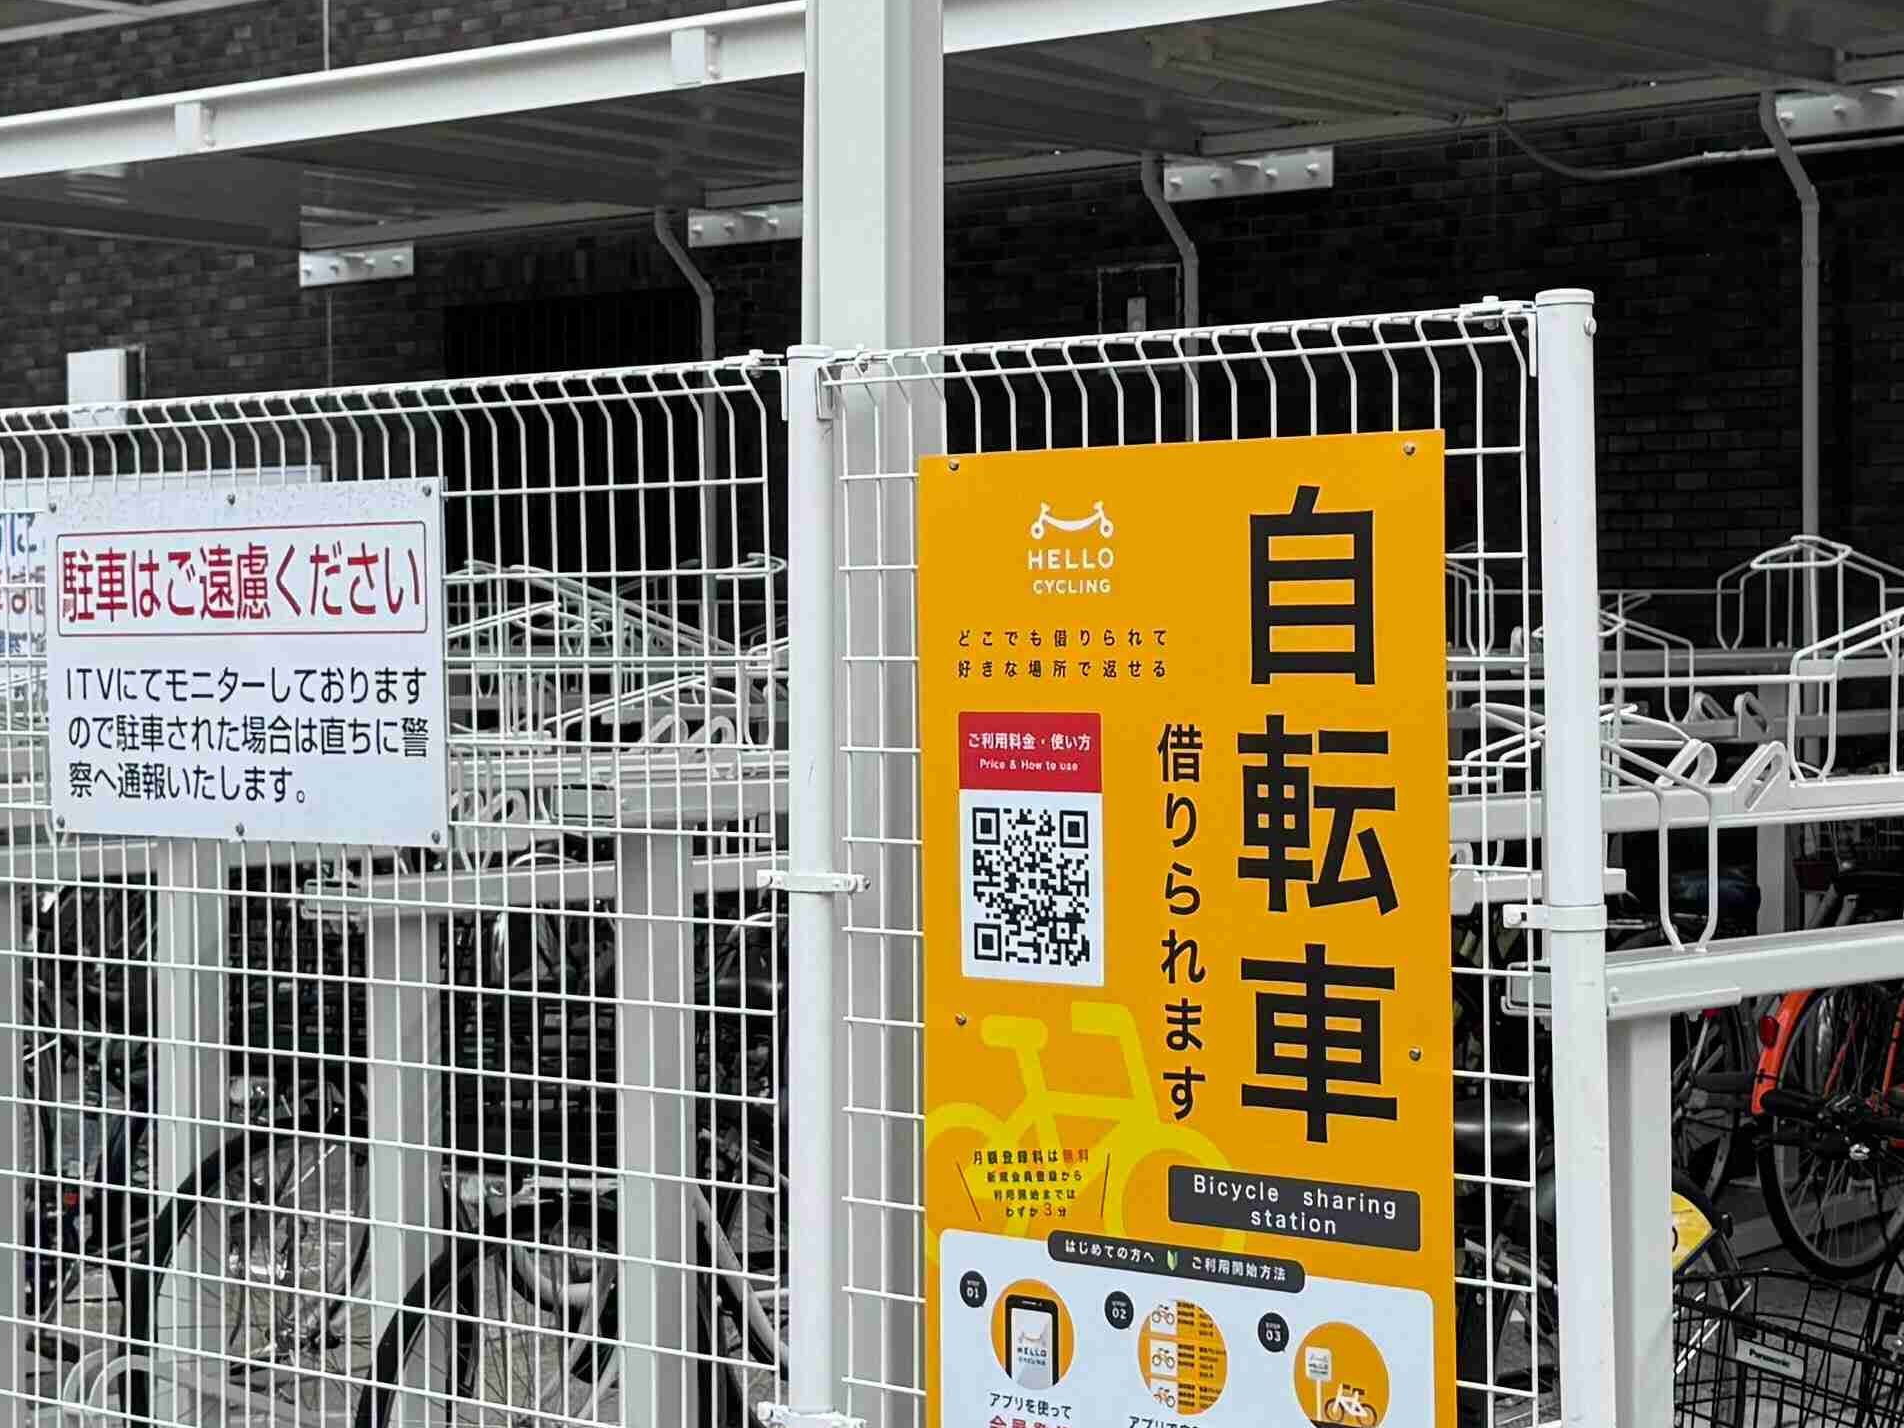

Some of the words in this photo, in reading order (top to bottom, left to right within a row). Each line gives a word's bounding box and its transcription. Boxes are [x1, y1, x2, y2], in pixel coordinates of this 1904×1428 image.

[1027, 547, 1115, 570] HELLO
[61, 539, 421, 622] 駐車はご遠慮ください
[1032, 578, 1112, 595] CYCLING
[957, 628, 1167, 648] どこでも借りられて
[957, 659, 1167, 679] 好きな場所で返せる
[65, 666, 428, 705] ITVにてモニターしております
[67, 715, 429, 758] ので駐車された場合は直ちに警
[968, 732, 1092, 751] ご利用料金・使い方
[979, 758, 1006, 770] Price
[1009, 759, 1017, 770] &
[1021, 759, 1043, 771] How
[1045, 761, 1058, 771] to
[1059, 762, 1079, 772] use
[68, 760, 307, 805] 察へ通報いたします。
[1236, 484, 1399, 1144] 自転車
[1157, 723, 1207, 1122] 借りられます
[1193, 1173, 1280, 1202] Bicycle
[1302, 1187, 1398, 1220] sharing
[1250, 1210, 1337, 1236] station
[1064, 1239, 1156, 1264] はじめての方へ
[1191, 1256, 1287, 1282] ご利用開始方法
[966, 1286, 980, 1298] 01
[1111, 1306, 1128, 1320] 02
[1265, 1329, 1282, 1343] 03
[989, 1392, 1072, 1419] アプリを使って
